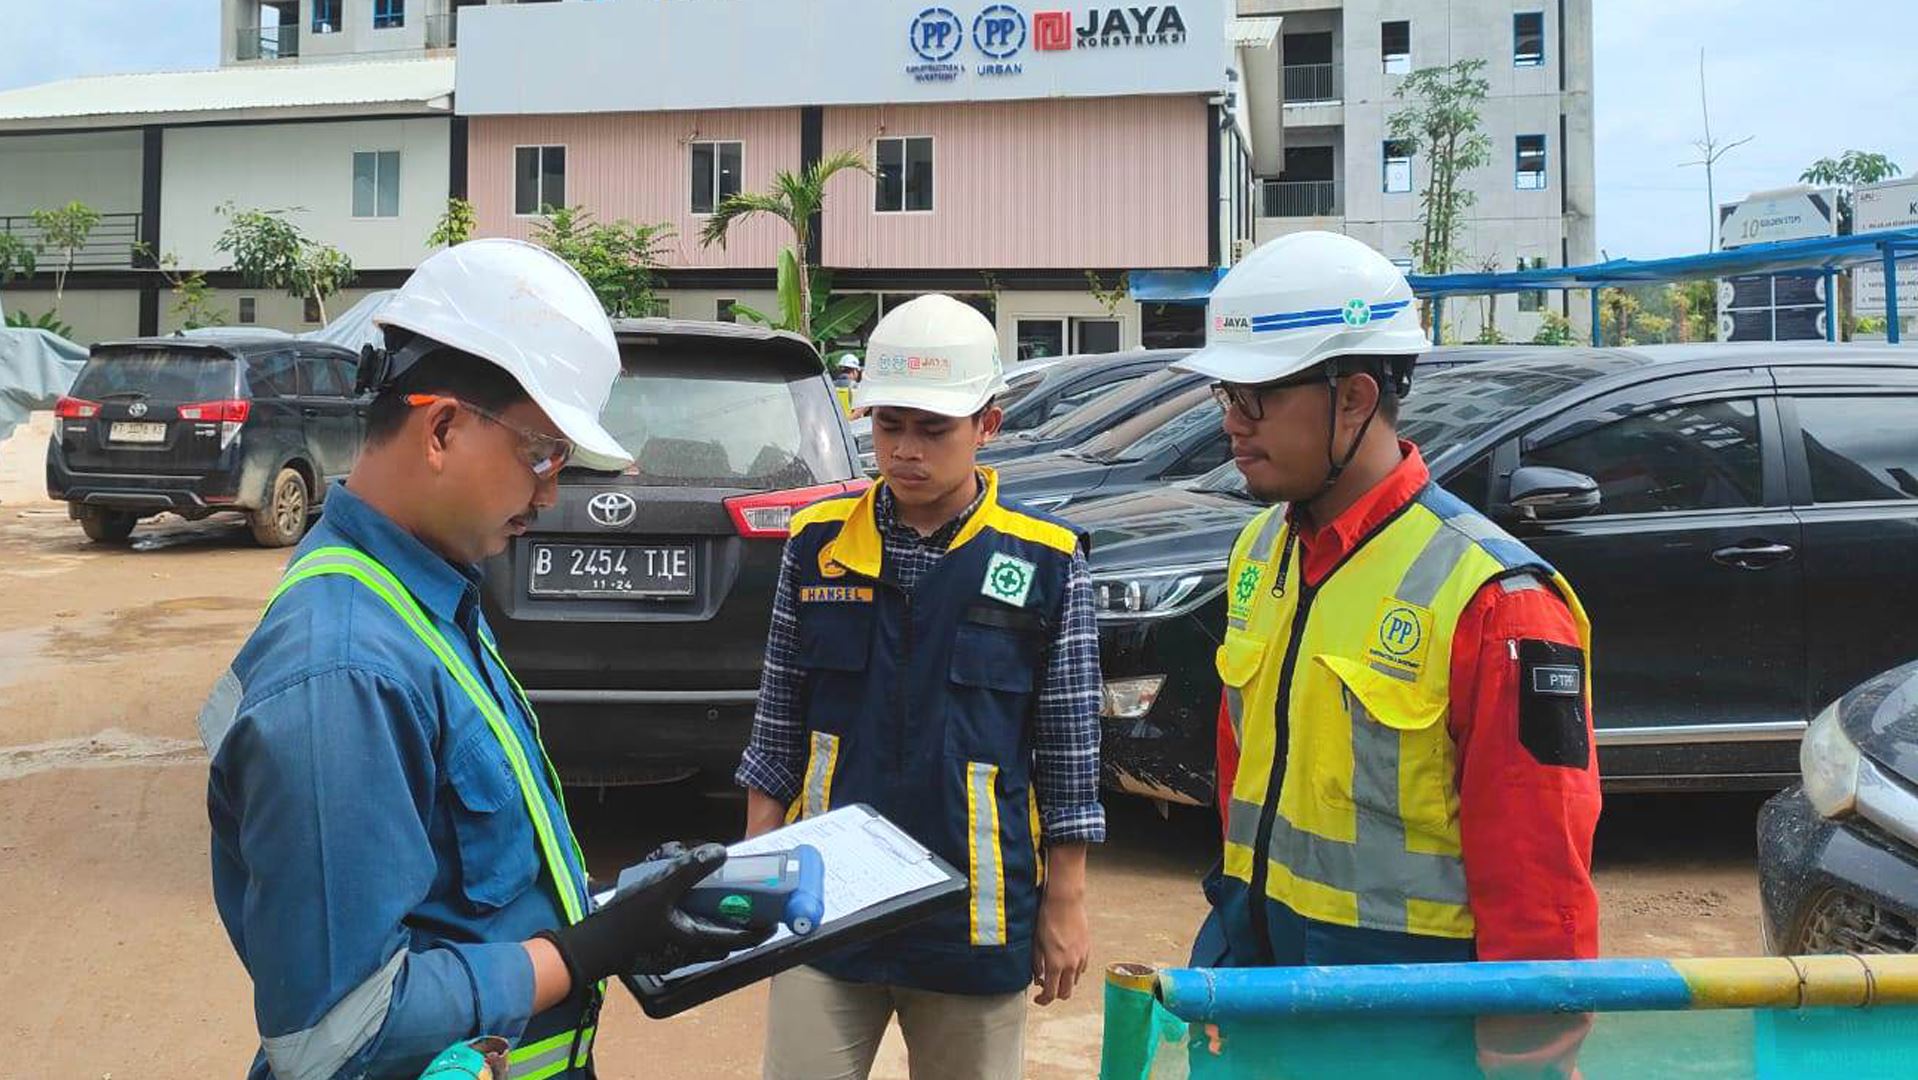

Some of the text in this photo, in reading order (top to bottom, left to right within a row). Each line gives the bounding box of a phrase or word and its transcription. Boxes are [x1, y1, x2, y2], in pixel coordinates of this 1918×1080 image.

[985, 18, 1016, 47] PP
[1075, 6, 1186, 36] JAYA
[921, 21, 952, 49] PP
[1077, 34, 1187, 49] KONSTRUKSI
[977, 64, 1022, 76] URBAN
[1741, 219, 1759, 239] 10
[1223, 316, 1249, 328] JAYA
[535, 548, 551, 575] B
[569, 549, 629, 576] 2454
[808, 587, 863, 601] HANSEL
[1388, 617, 1412, 644] PP
